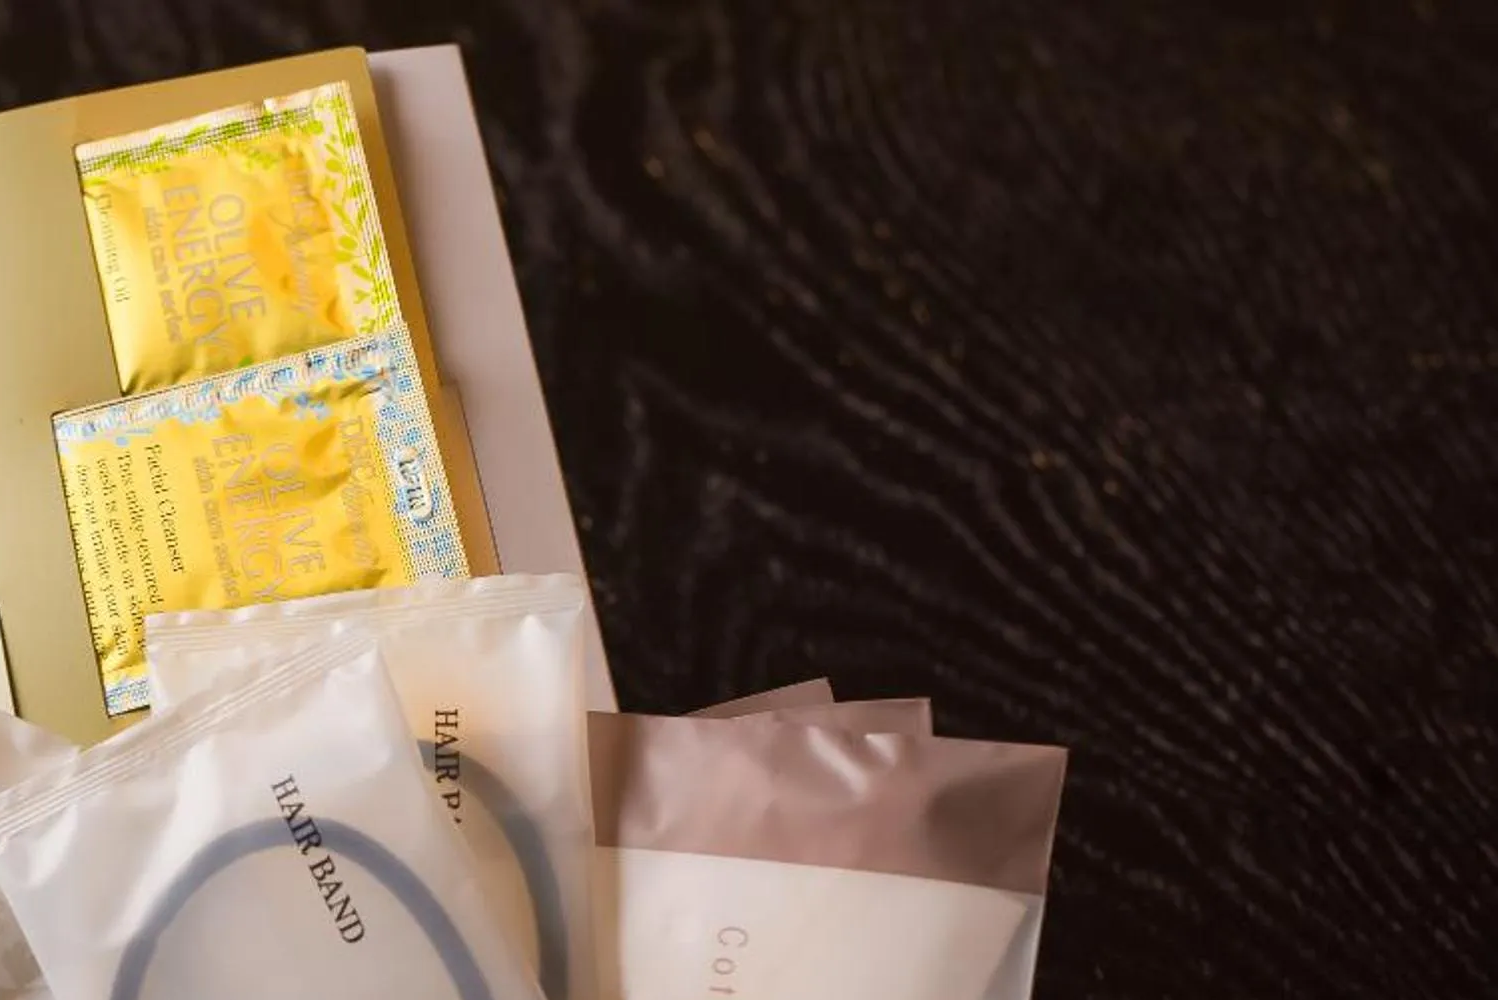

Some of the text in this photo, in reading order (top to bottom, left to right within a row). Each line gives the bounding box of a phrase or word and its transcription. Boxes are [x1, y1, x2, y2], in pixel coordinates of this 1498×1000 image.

[162, 184, 234, 348] ENERGY
[208, 193, 267, 320] OLIVE
[97, 458, 116, 496] wash
[106, 518, 129, 564] gentle
[145, 443, 184, 572] Facial Cleanser
[211, 432, 287, 600] ENERGY
[260, 441, 326, 578] OLIVE
[434, 709, 460, 783] HAIR
[271, 774, 366, 944] HAIR BAND
